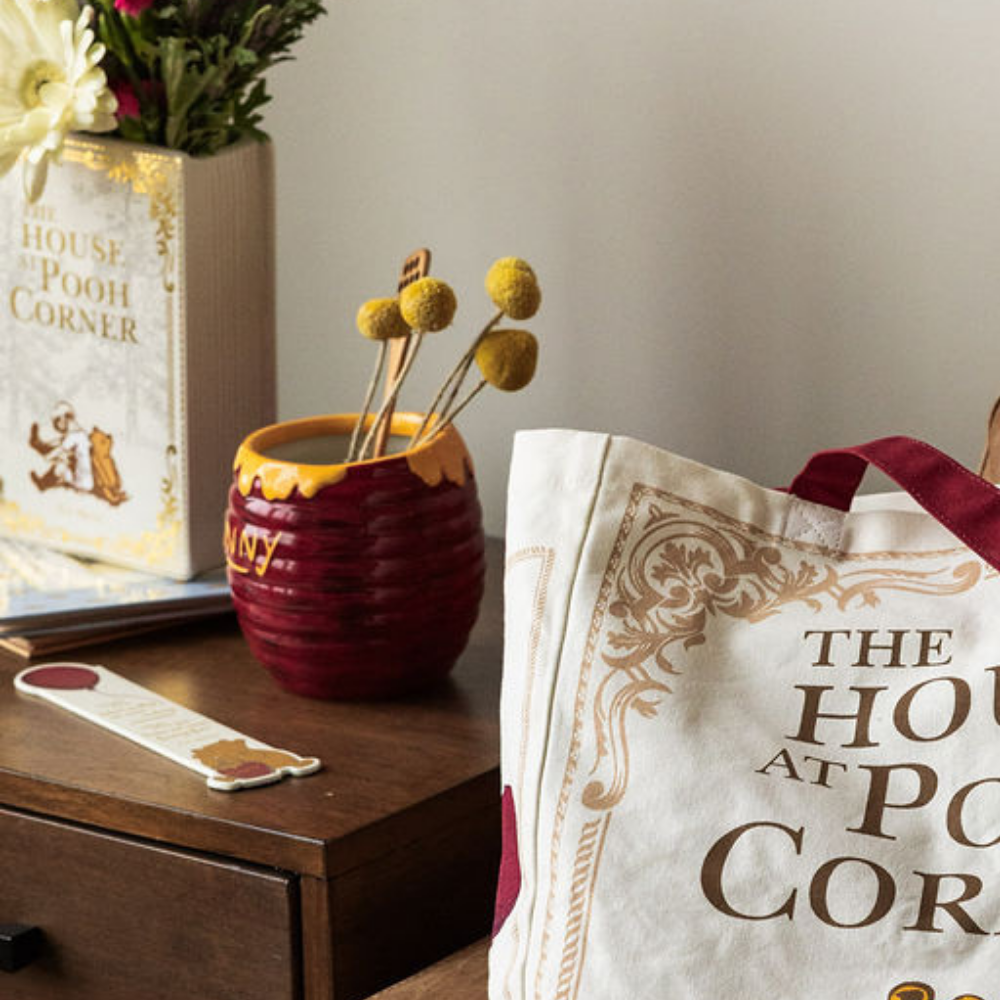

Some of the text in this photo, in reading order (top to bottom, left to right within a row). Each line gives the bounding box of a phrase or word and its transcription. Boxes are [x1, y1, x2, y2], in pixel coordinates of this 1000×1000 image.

[22, 223, 126, 268] HOUSE
[41, 256, 130, 309] POOH
[9, 285, 139, 344] CORNER
[804, 629, 953, 668] THE
[755, 747, 848, 789] AT
